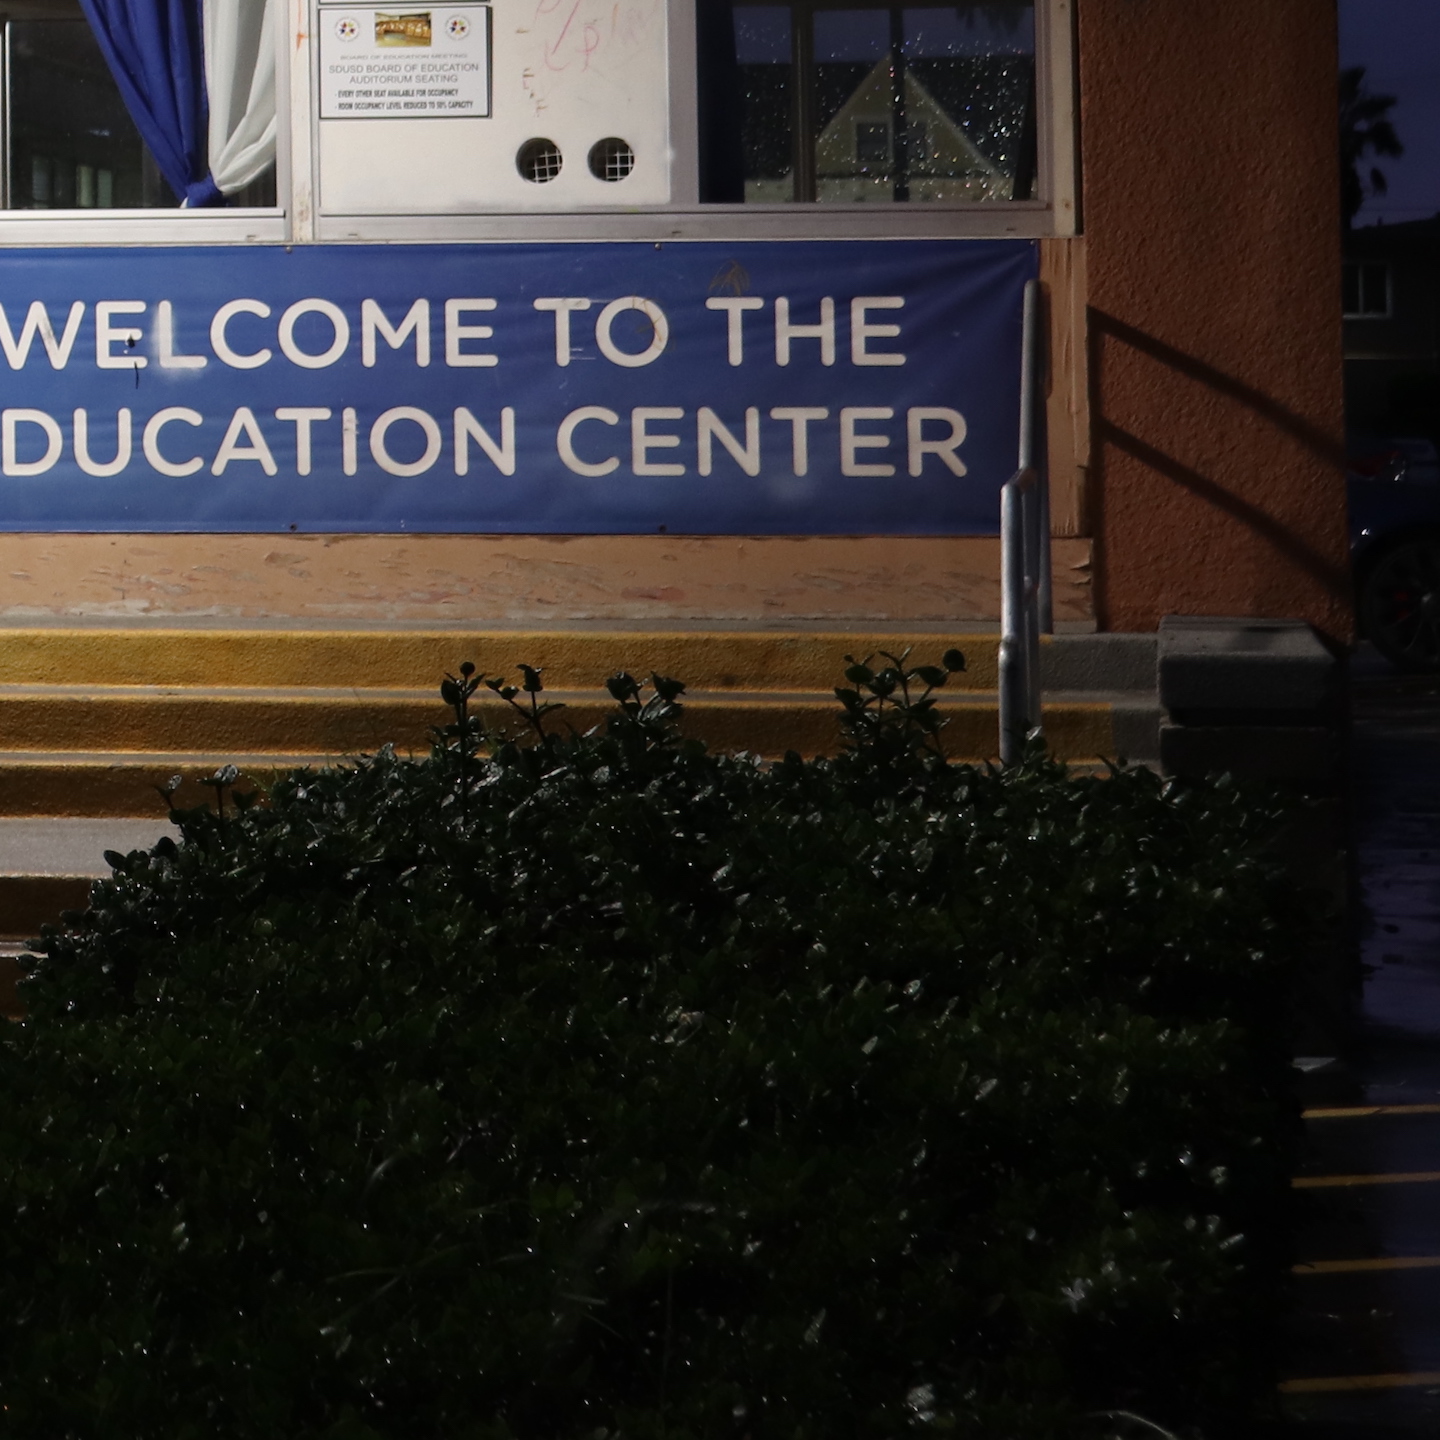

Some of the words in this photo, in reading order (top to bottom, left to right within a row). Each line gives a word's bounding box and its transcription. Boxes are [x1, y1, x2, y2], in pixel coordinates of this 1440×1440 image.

[328, 65, 364, 74] SDUSD
[366, 64, 401, 73] BOARD
[404, 64, 418, 73] OF
[420, 63, 479, 72] EDUCATION
[349, 75, 412, 84] AUDITORIUM
[415, 74, 458, 83] SEATING
[338, 90, 355, 98] EVERY
[355, 90, 372, 98] OTHER
[374, 89, 387, 98] SEAT
[387, 89, 415, 97] AVAILABLE
[416, 89, 426, 97] FOR
[427, 89, 459, 97] OCCUPANCY
[338, 102, 353, 110] ROOM
[354, 102, 385, 110] OCCUPANCY
[386, 102, 402, 110] LEVEL
[448, 101, 474, 109] CAPACITY
[533, 296, 669, 368] TO
[705, 296, 907, 368] THE
[556, 404, 969, 479] CENTER
